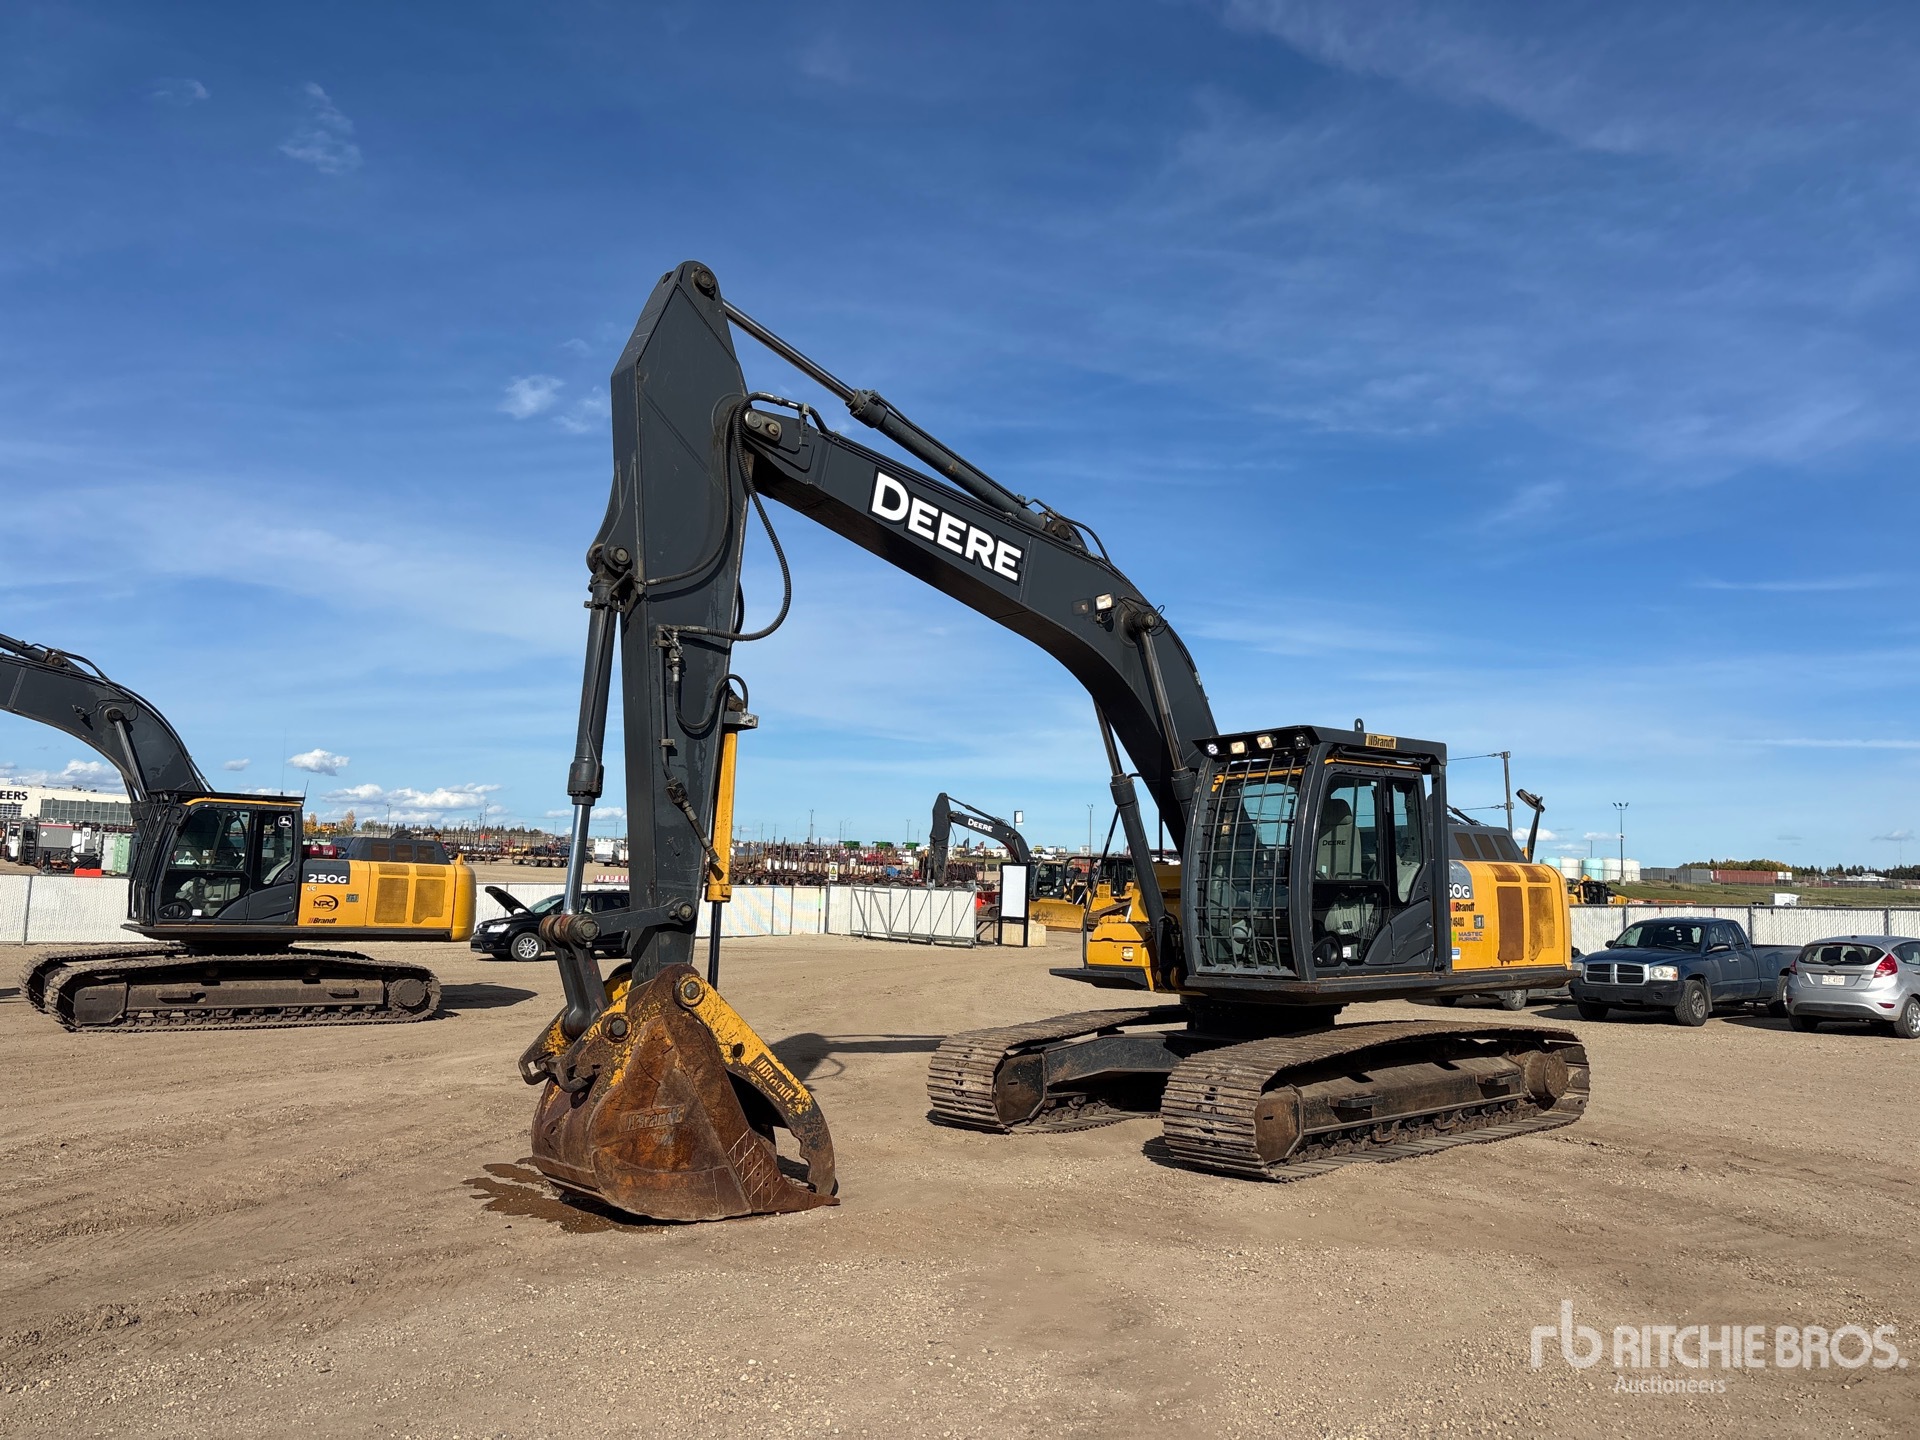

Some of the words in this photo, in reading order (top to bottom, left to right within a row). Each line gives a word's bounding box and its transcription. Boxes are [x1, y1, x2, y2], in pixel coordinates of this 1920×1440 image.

[871, 471, 1022, 581] DEERE
[1371, 736, 1395, 748] Brandt
[0, 790, 28, 800] EERS
[967, 818, 993, 832] DEERE
[308, 874, 347, 883] 250G
[1455, 902, 1475, 912] Brandt
[756, 1060, 795, 1101] Brandt
